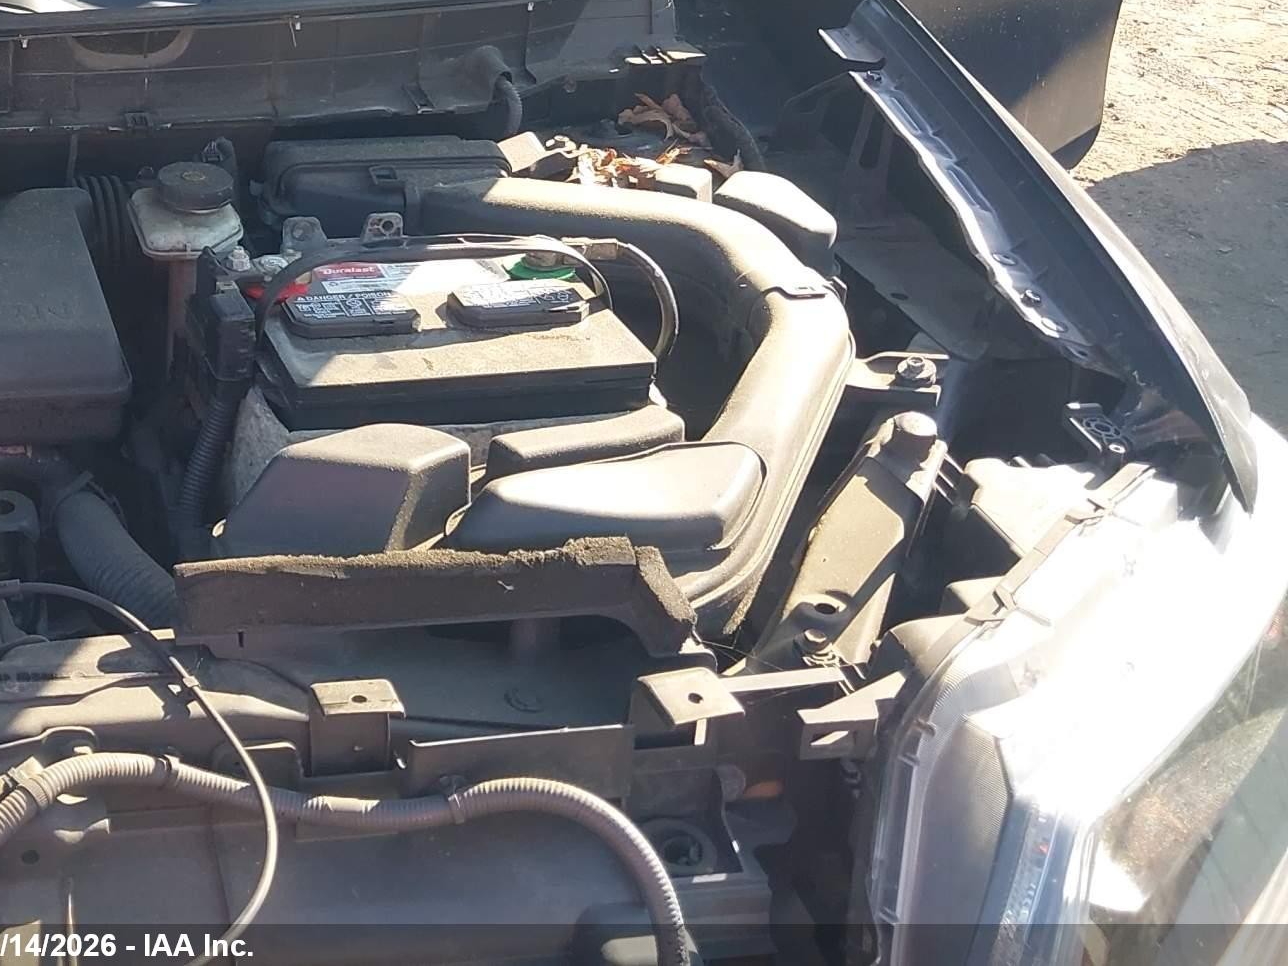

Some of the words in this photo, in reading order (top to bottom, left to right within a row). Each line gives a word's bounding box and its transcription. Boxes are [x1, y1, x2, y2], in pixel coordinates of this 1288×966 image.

[322, 266, 376, 274] Duralast
[306, 292, 345, 301] DANGER
[355, 291, 391, 299] POISON
